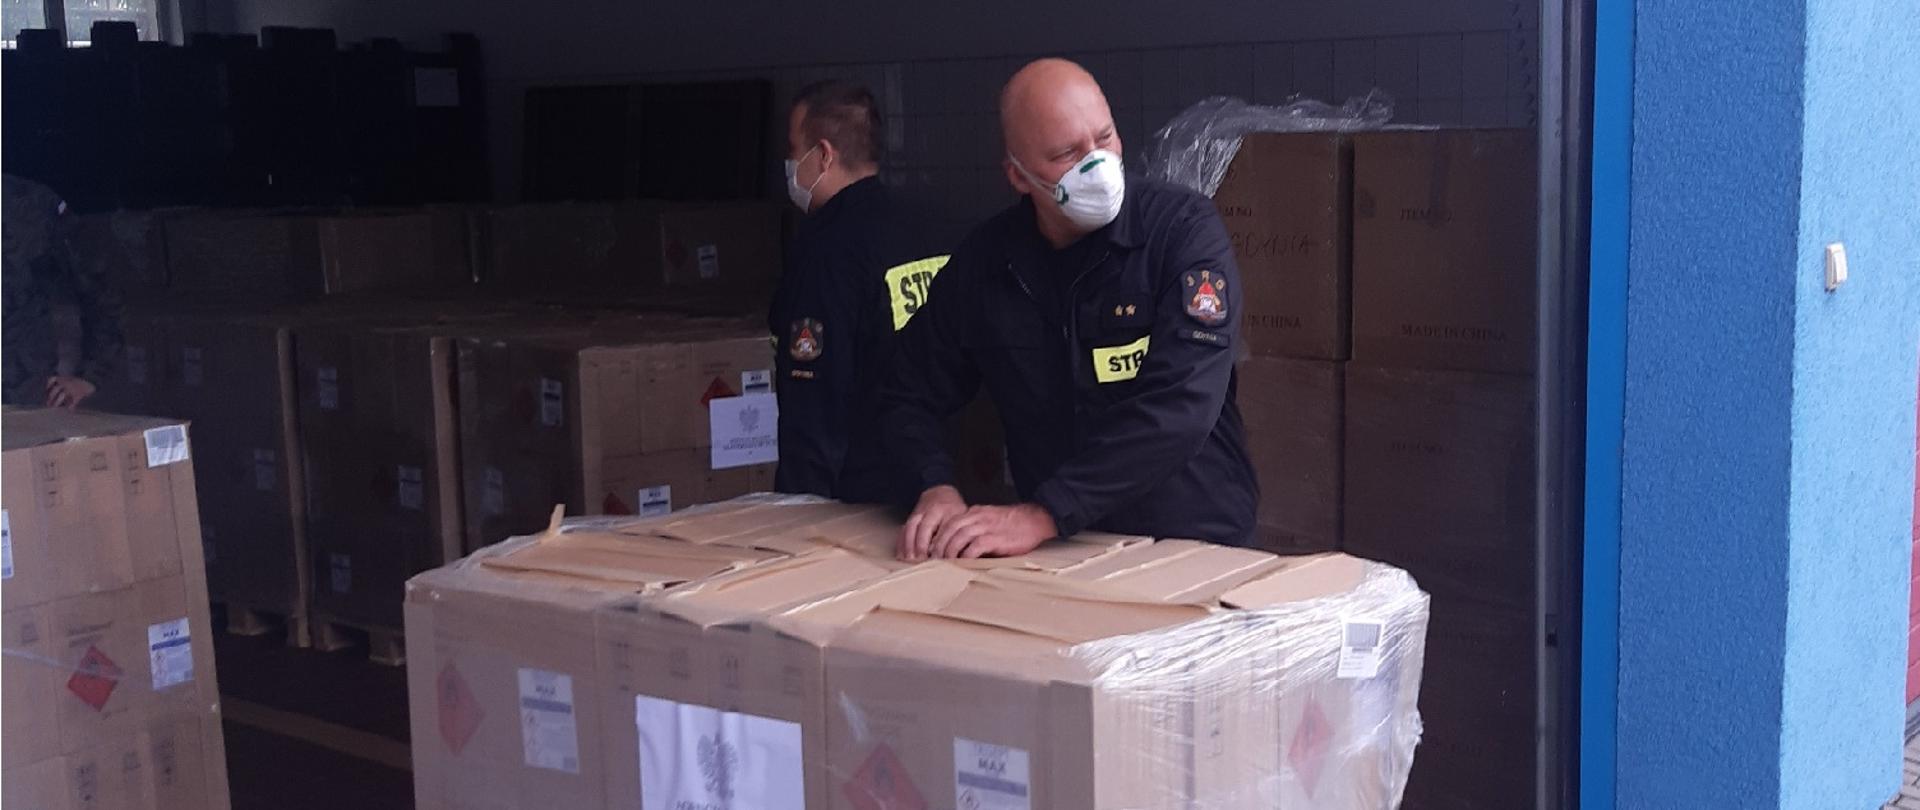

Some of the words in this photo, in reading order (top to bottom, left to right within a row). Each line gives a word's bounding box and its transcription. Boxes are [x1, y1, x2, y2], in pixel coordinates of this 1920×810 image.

[1262, 314, 1303, 328] CHINA
[1401, 323, 1440, 337] MADE
[1443, 325, 1459, 338] IN
[1461, 326, 1507, 342] CHINA
[978, 756, 1007, 774] MAX
